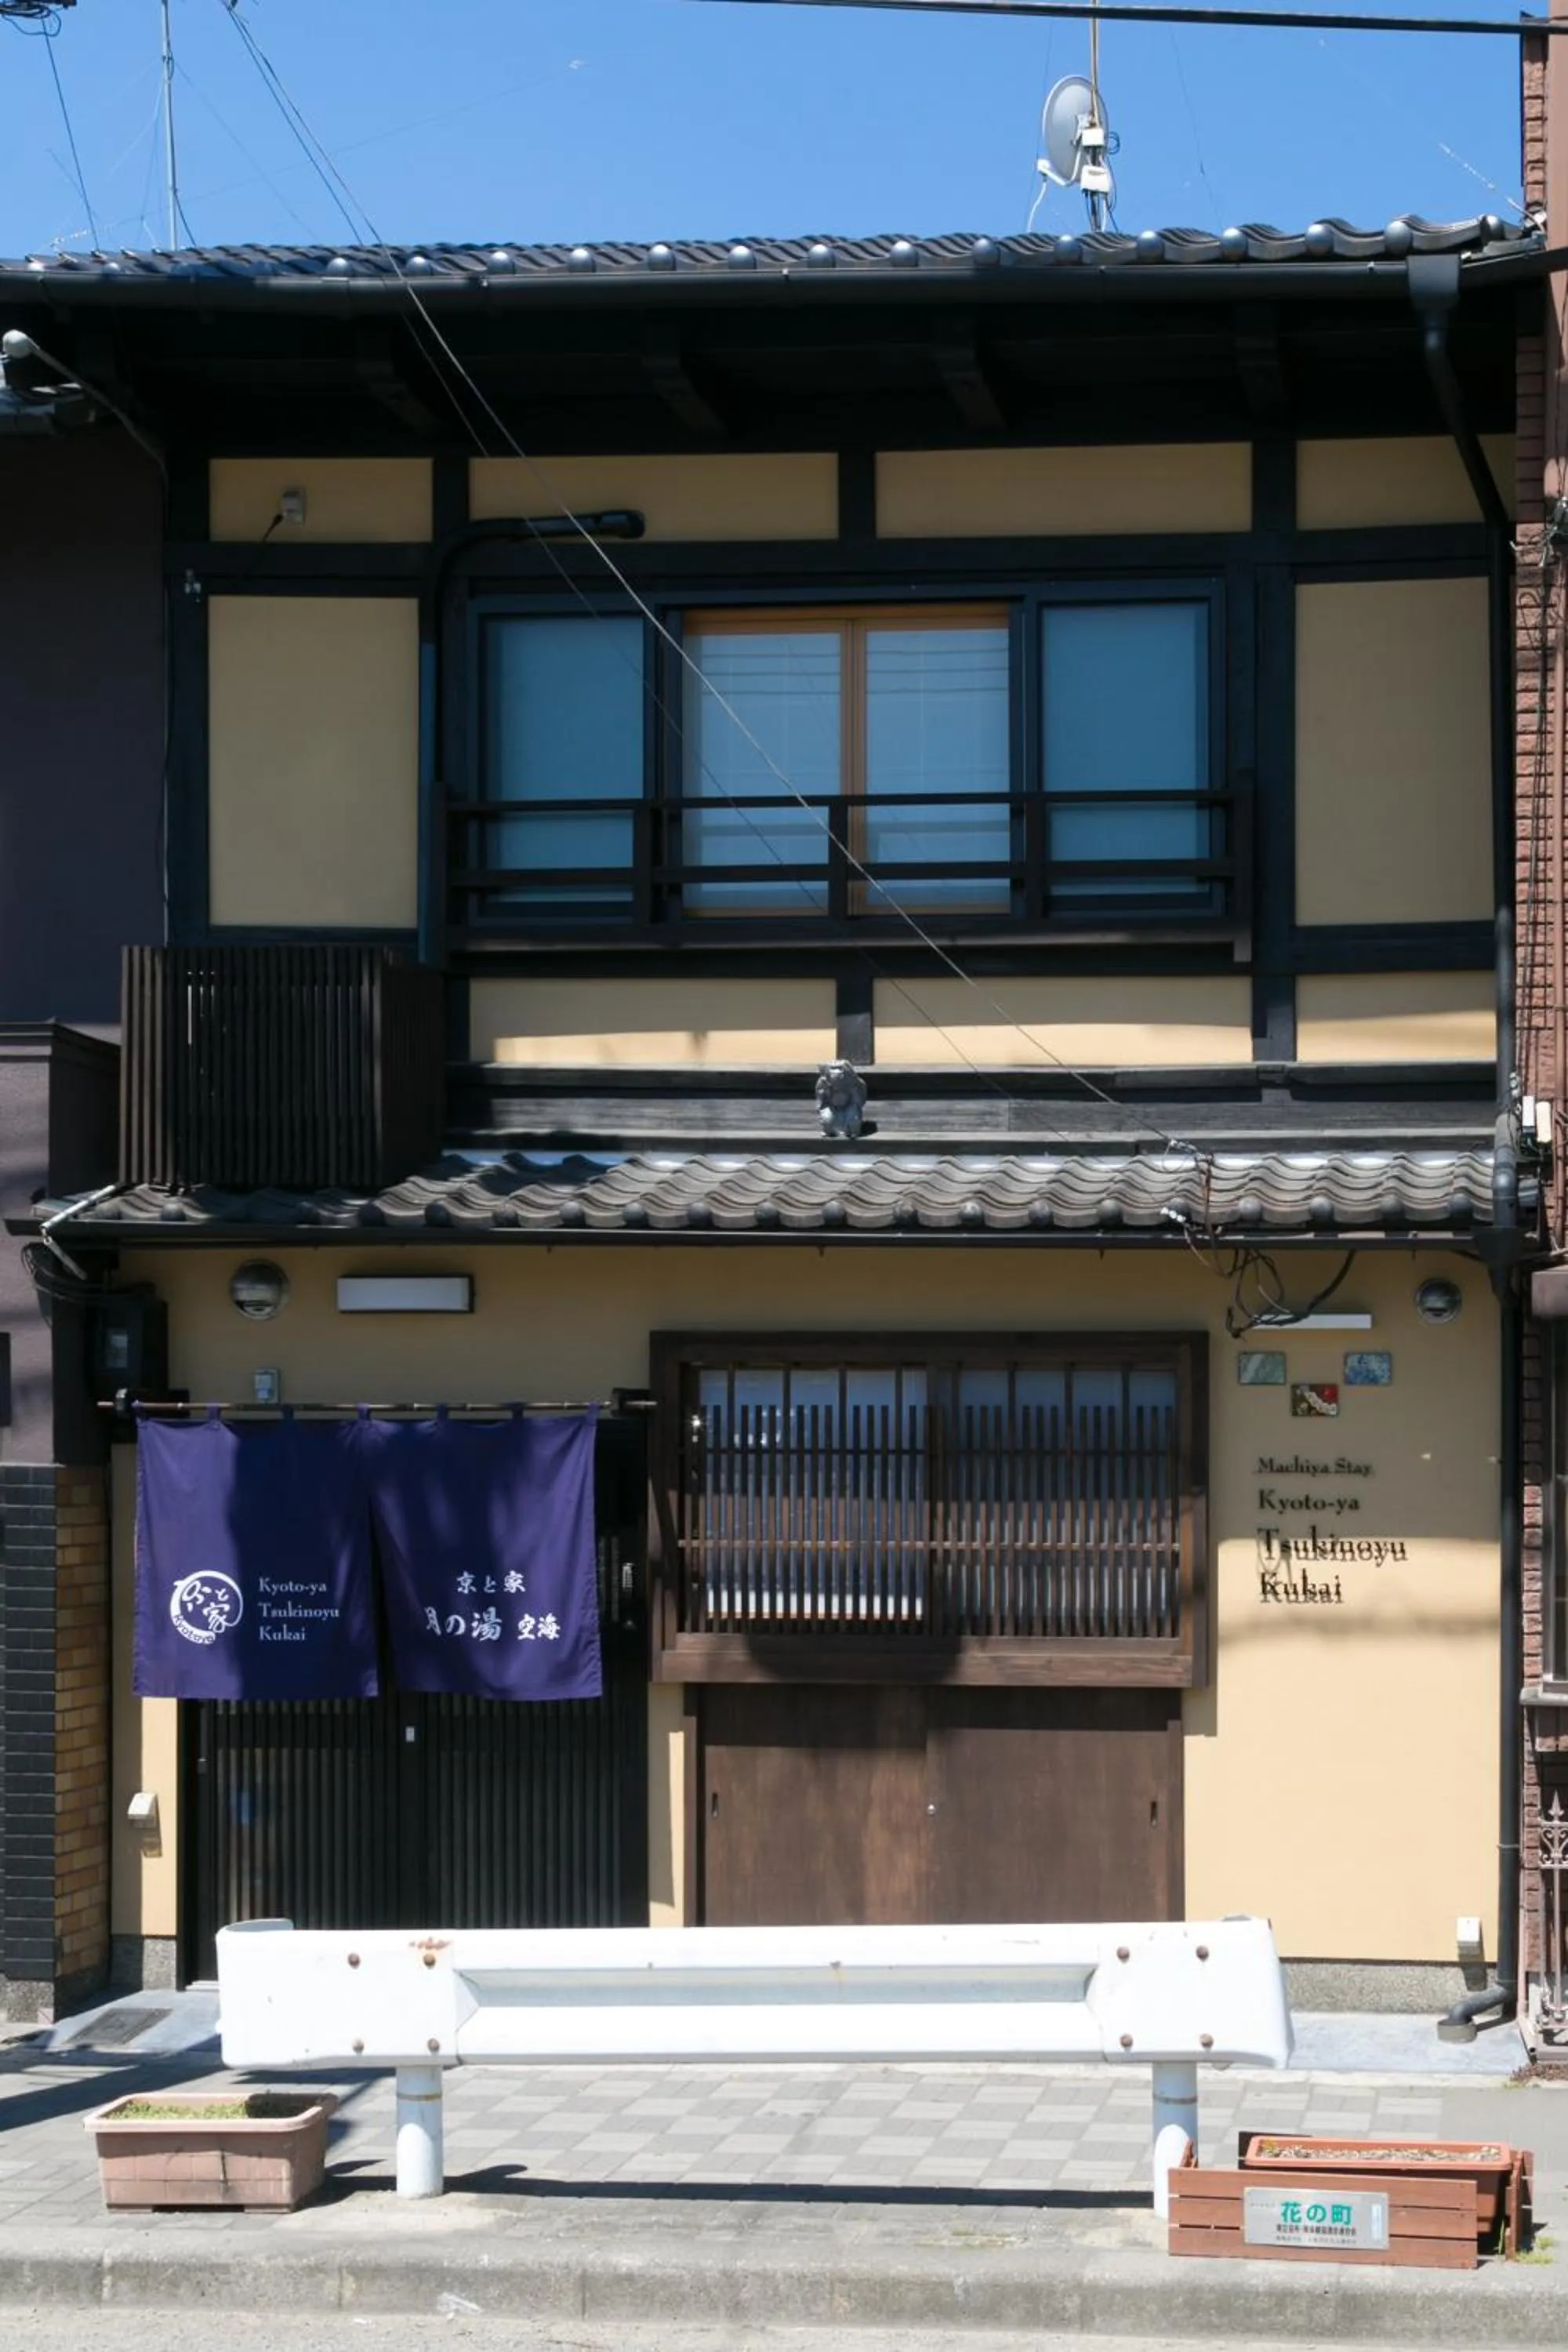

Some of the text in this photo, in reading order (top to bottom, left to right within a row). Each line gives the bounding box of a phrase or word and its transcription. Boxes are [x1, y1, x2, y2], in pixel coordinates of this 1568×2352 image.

[1258, 1455, 1373, 1477] Machiya Stay
[1258, 1490, 1359, 1515] Kyoto-ya
[1257, 1525, 1406, 1566] Tsukinoyu
[259, 1577, 327, 1595] Kyoto-ya
[456, 1570, 526, 1594] 京と家
[1261, 1569, 1343, 1603] Kukai
[258, 1601, 339, 1621] Tsukinoyu
[259, 1624, 306, 1641] Kukai
[517, 1613, 561, 1640] 空海
[1280, 2201, 1353, 2225] 花の町
